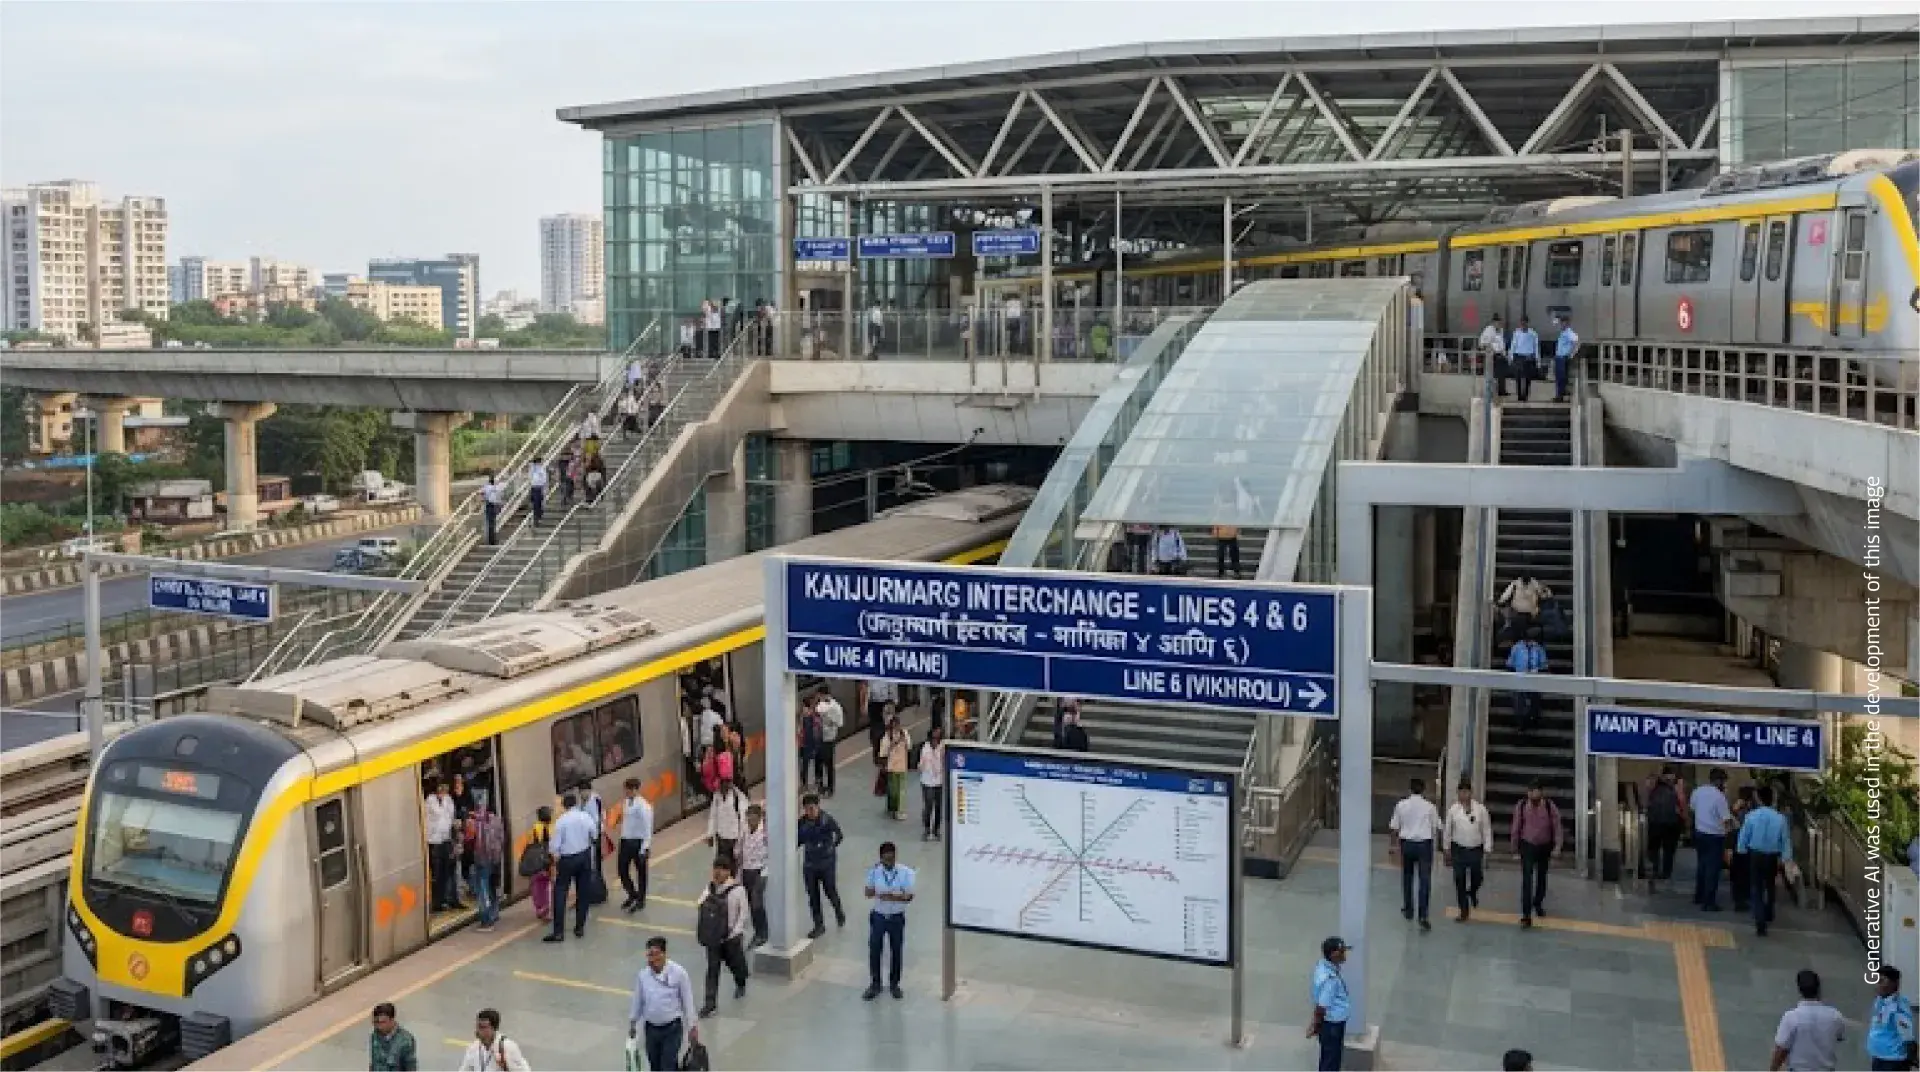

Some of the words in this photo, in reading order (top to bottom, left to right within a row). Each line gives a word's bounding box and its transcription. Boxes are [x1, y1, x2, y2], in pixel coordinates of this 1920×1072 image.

[803, 571, 961, 609] KANJURMARG
[967, 581, 1140, 620] INTERCHANGE
[1163, 593, 1237, 628] LINES
[1243, 599, 1259, 629] 4
[1265, 600, 1285, 632] &
[1292, 601, 1308, 632] 6
[824, 644, 862, 669] LINE
[864, 648, 876, 669] 4
[1123, 668, 1166, 693] LINE
[1170, 672, 1183, 694] 6
[1594, 714, 1639, 733] MAIN
[1756, 725, 1800, 748] LINE
